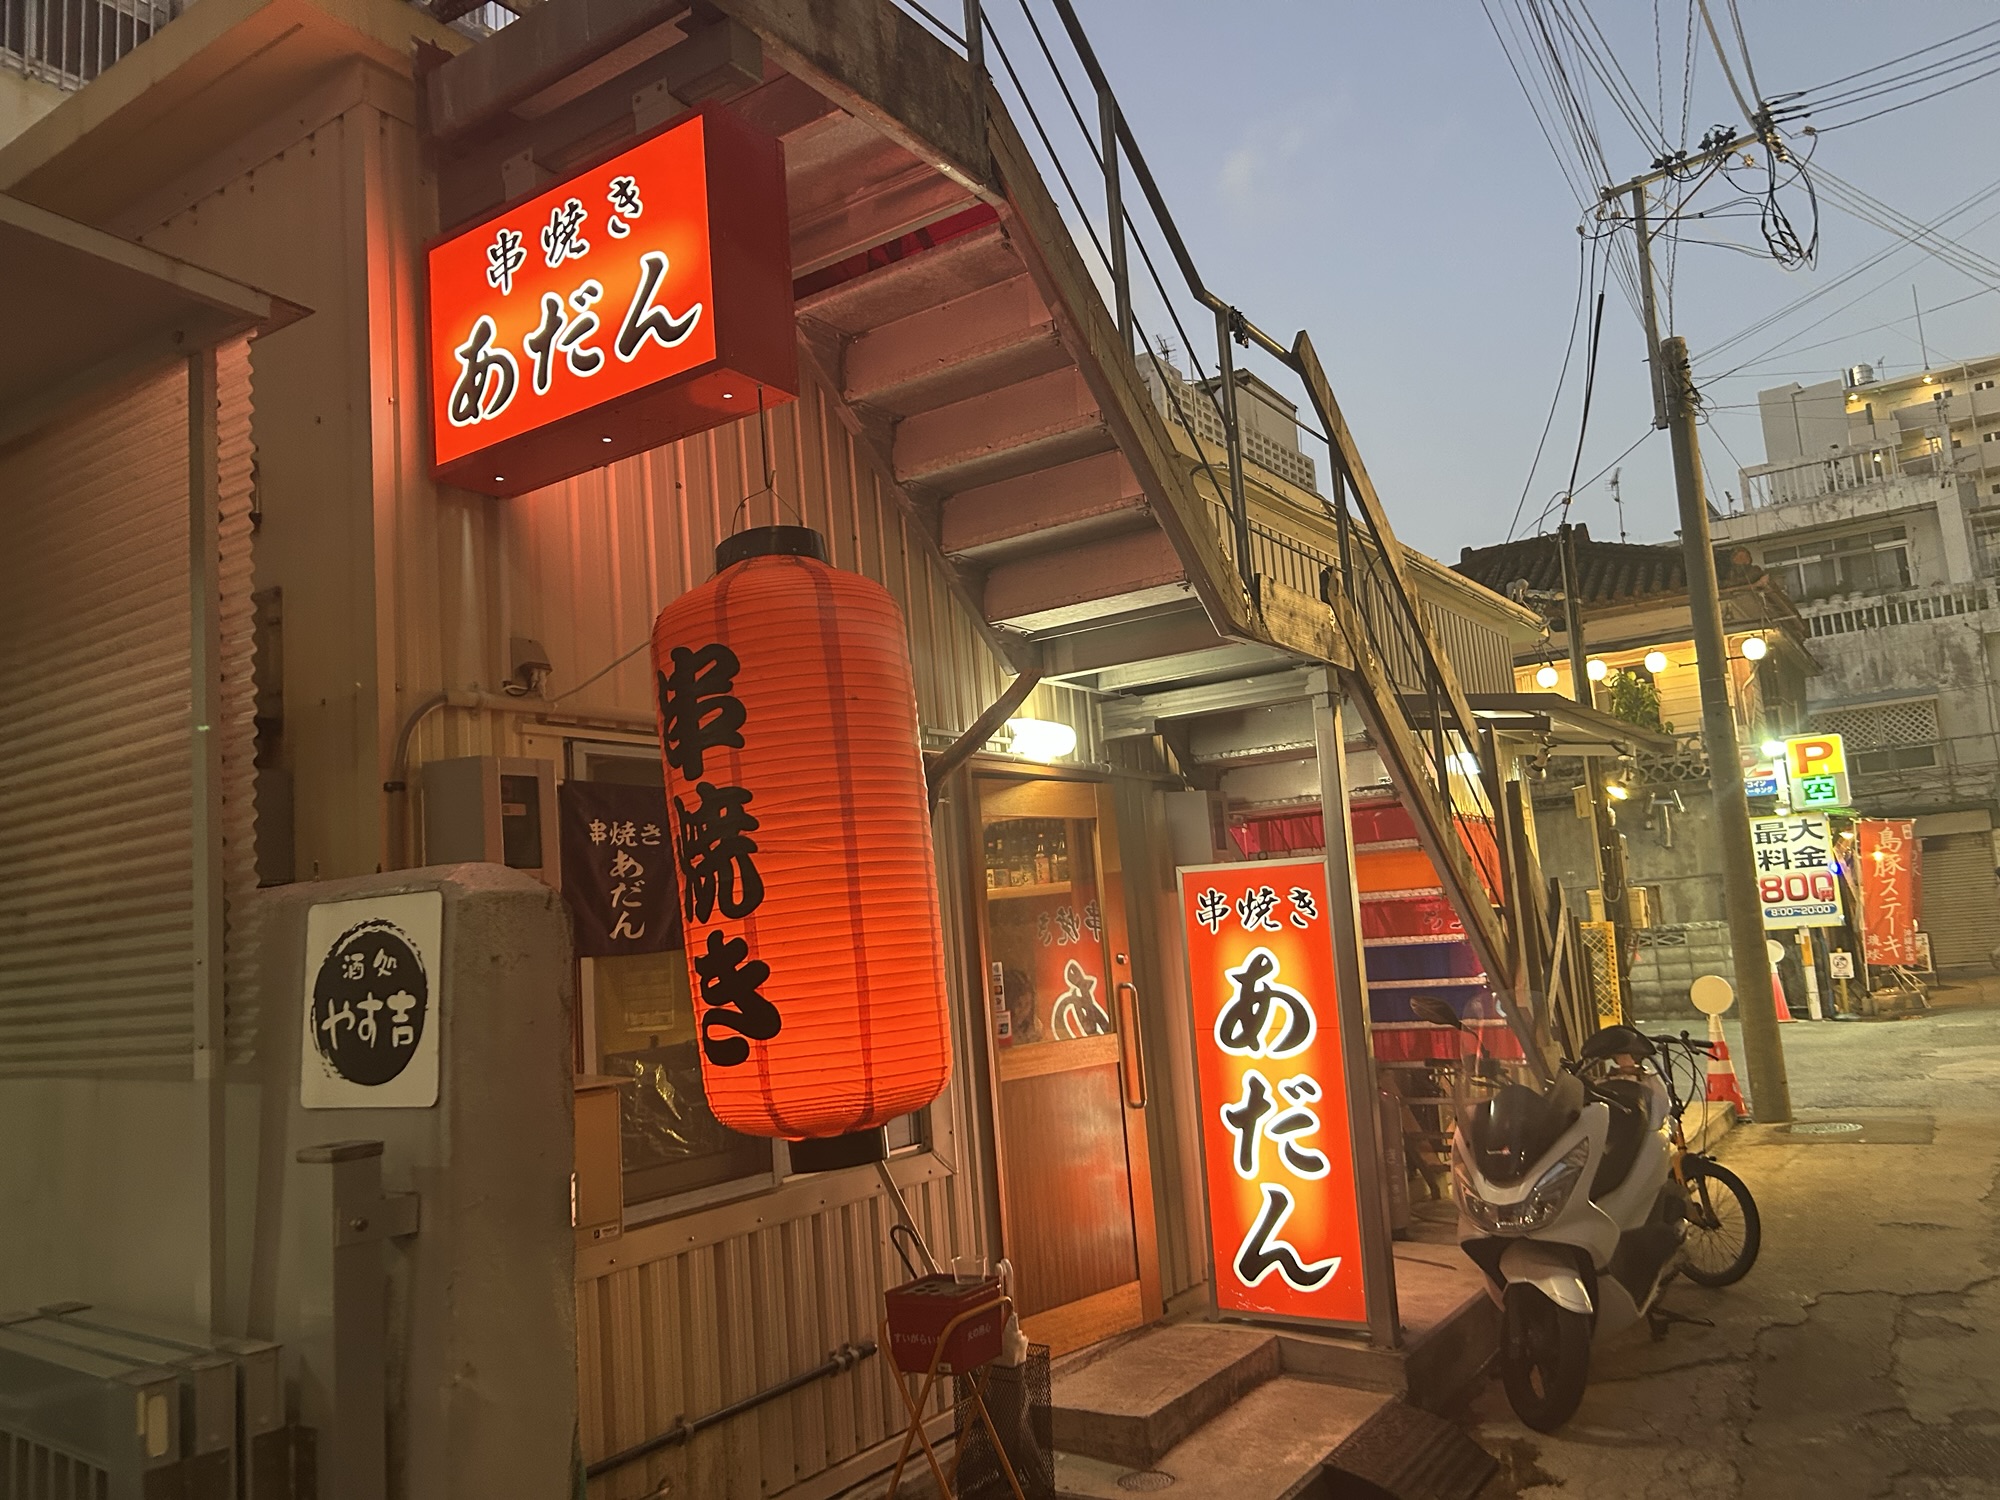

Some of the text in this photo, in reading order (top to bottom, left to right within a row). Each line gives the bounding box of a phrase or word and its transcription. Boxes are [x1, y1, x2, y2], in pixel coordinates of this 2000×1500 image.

[487, 176, 643, 295] 串焼き
[448, 251, 702, 427] あだん
[1796, 742, 1833, 774] P
[1803, 776, 1838, 806] 空
[588, 819, 662, 846] 串焼き
[658, 643, 782, 1067] 串焼き
[1754, 819, 1824, 844] 最大
[1757, 846, 1828, 871] 料金
[609, 850, 645, 940] あだん
[1195, 885, 1319, 934] 串焼き
[1873, 827, 1907, 958] 島豚ステーキ
[342, 948, 397, 980] 酒処
[321, 989, 416, 1050] やす吉
[1213, 946, 1342, 1293] あだん
